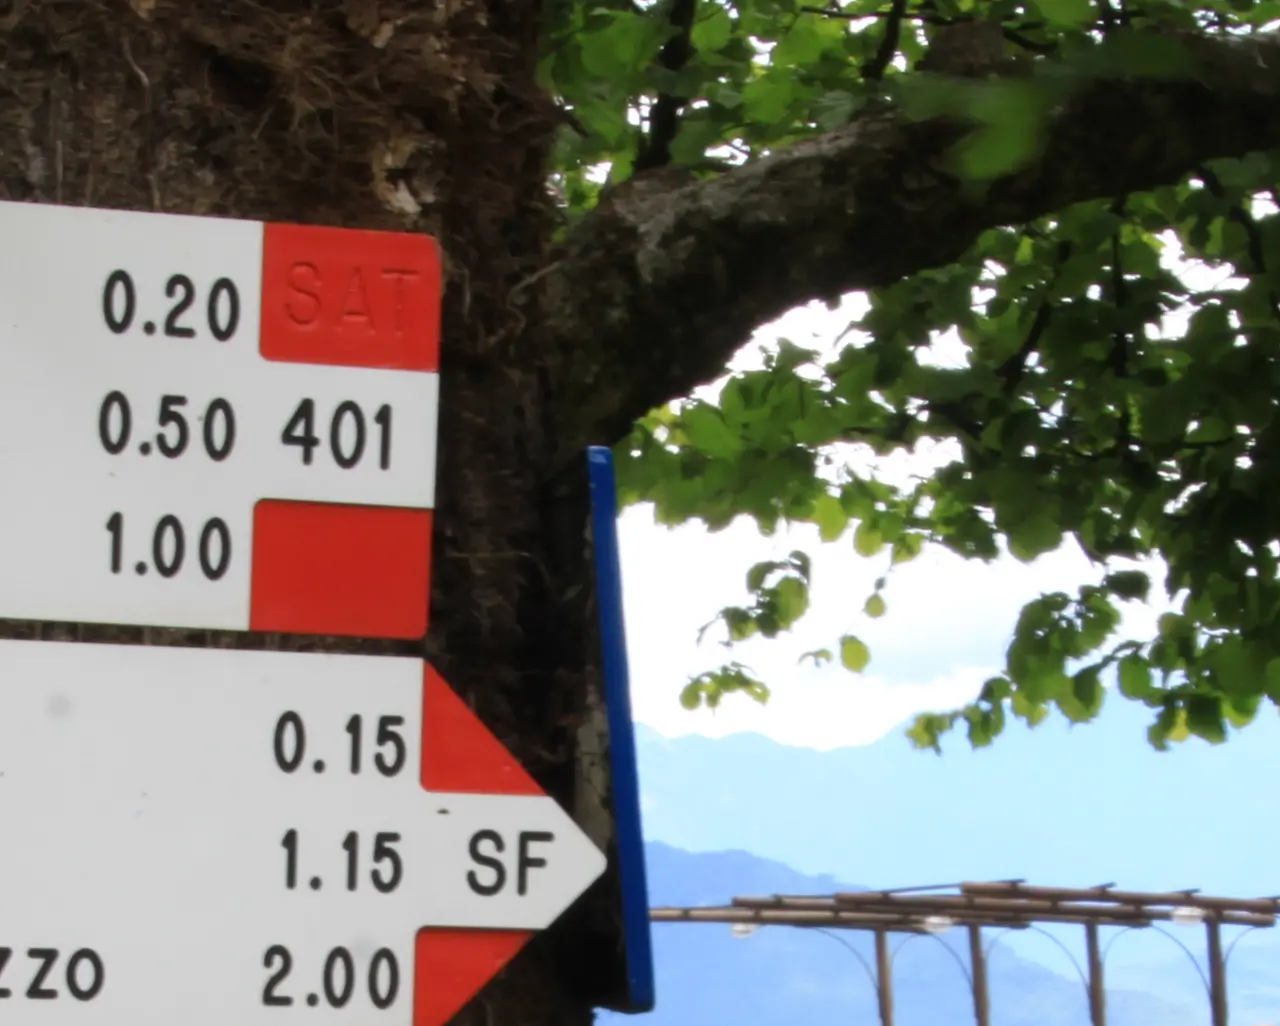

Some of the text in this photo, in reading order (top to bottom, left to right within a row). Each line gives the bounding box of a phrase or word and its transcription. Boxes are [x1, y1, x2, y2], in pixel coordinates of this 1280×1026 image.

[102, 269, 241, 343] 0.20
[283, 260, 420, 337] SAT
[98, 390, 237, 463] 0.50
[281, 397, 393, 471] 401
[106, 511, 233, 582] 1.00
[273, 710, 407, 779] 0.15
[281, 828, 405, 897] 1.15
[466, 829, 556, 898] SF
[262, 944, 401, 1013] 2.00
